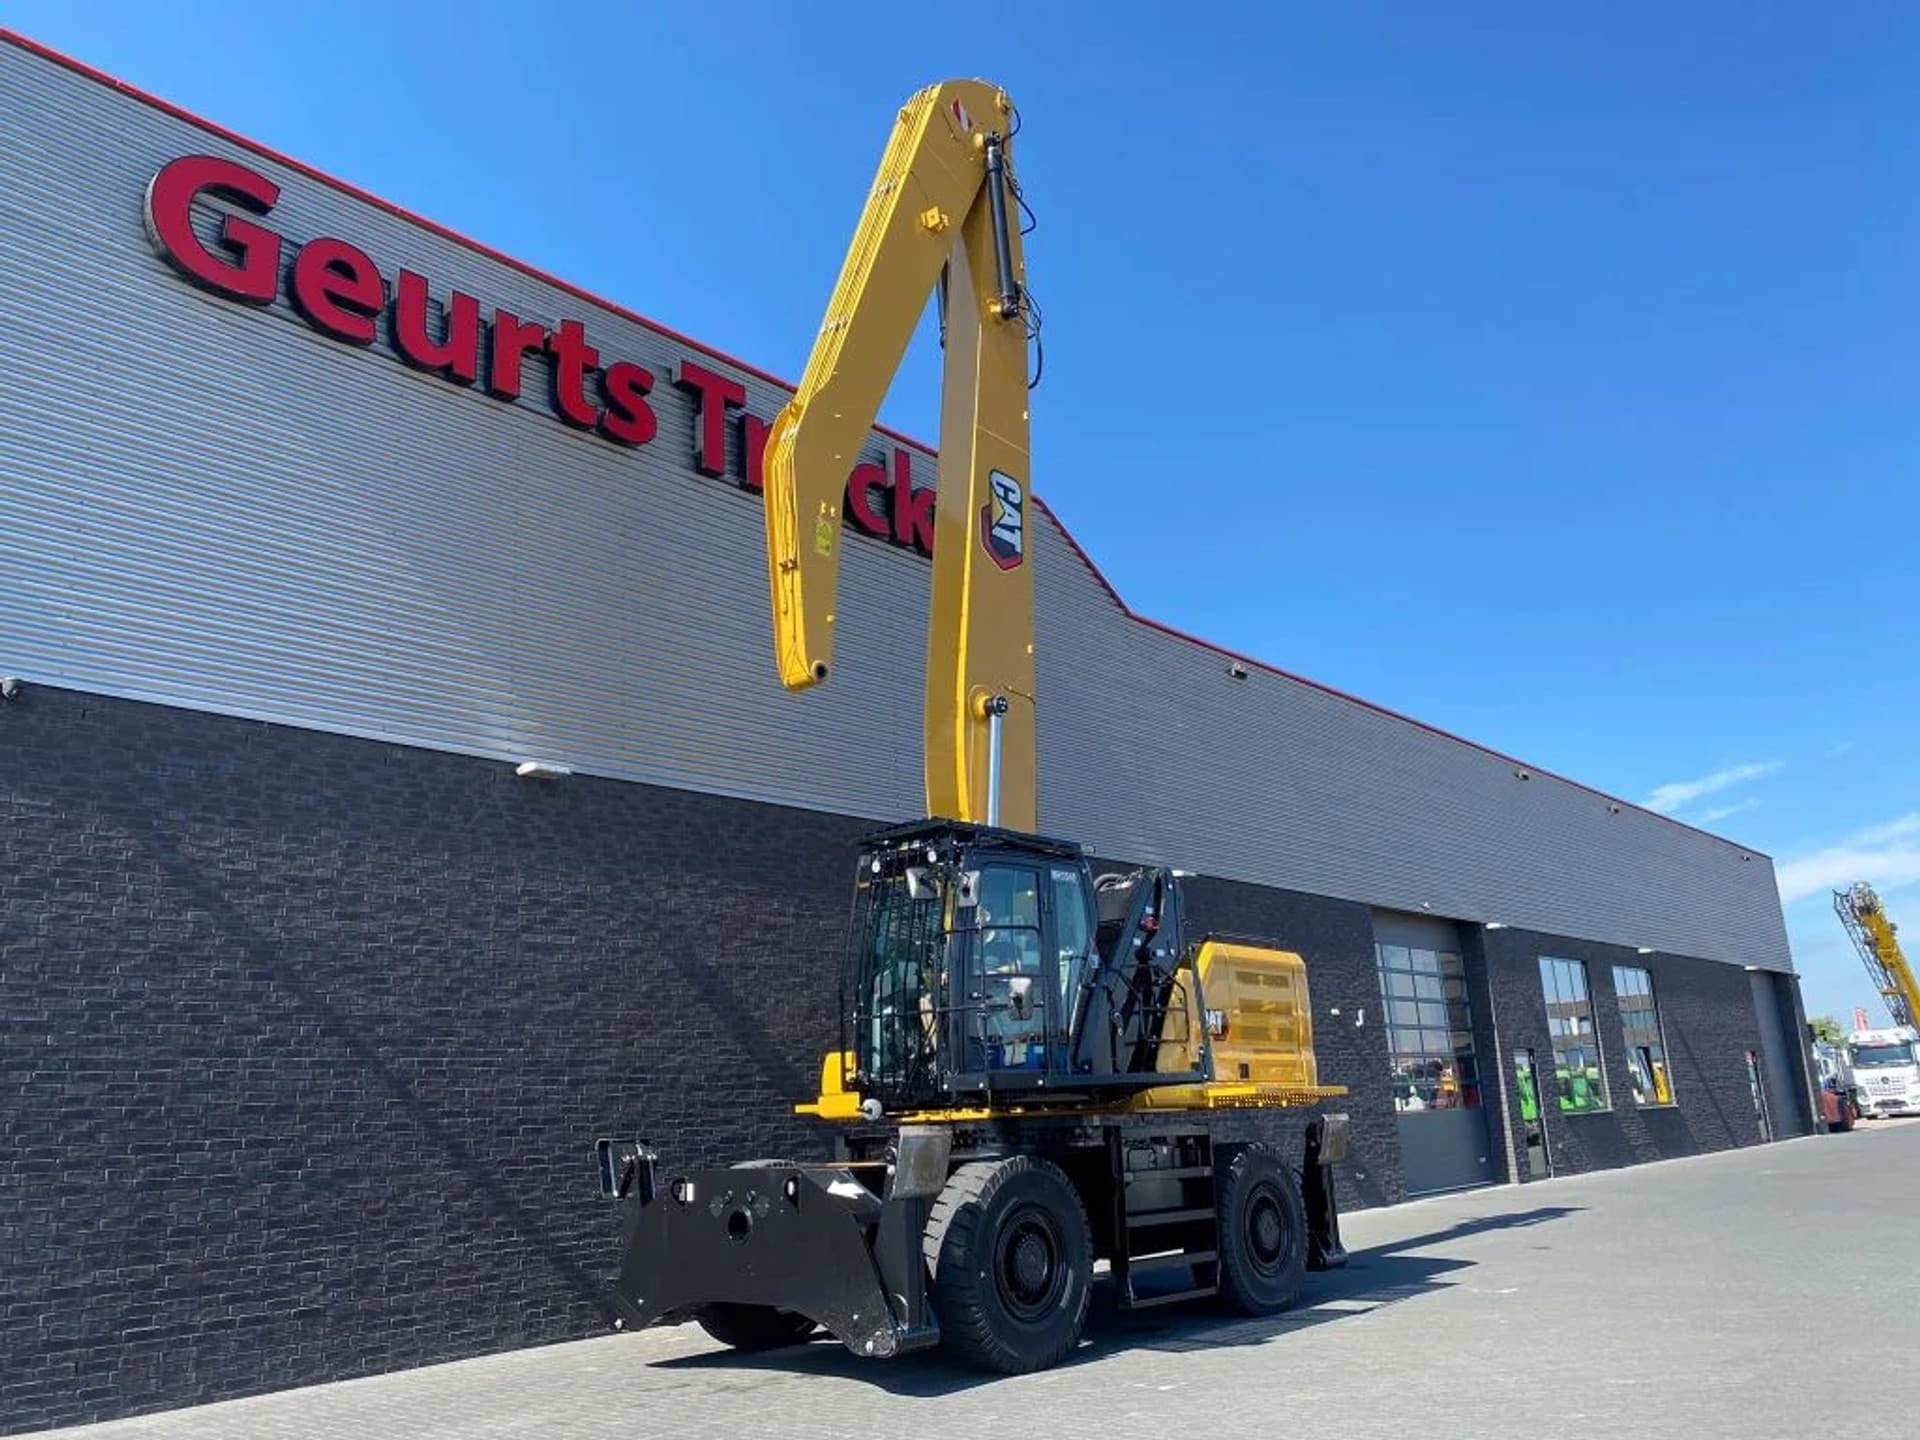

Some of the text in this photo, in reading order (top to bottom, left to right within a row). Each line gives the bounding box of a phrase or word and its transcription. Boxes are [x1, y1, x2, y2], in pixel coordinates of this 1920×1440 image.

[147, 155, 937, 554] Geurts Trck
[989, 470, 1021, 553] CAT
